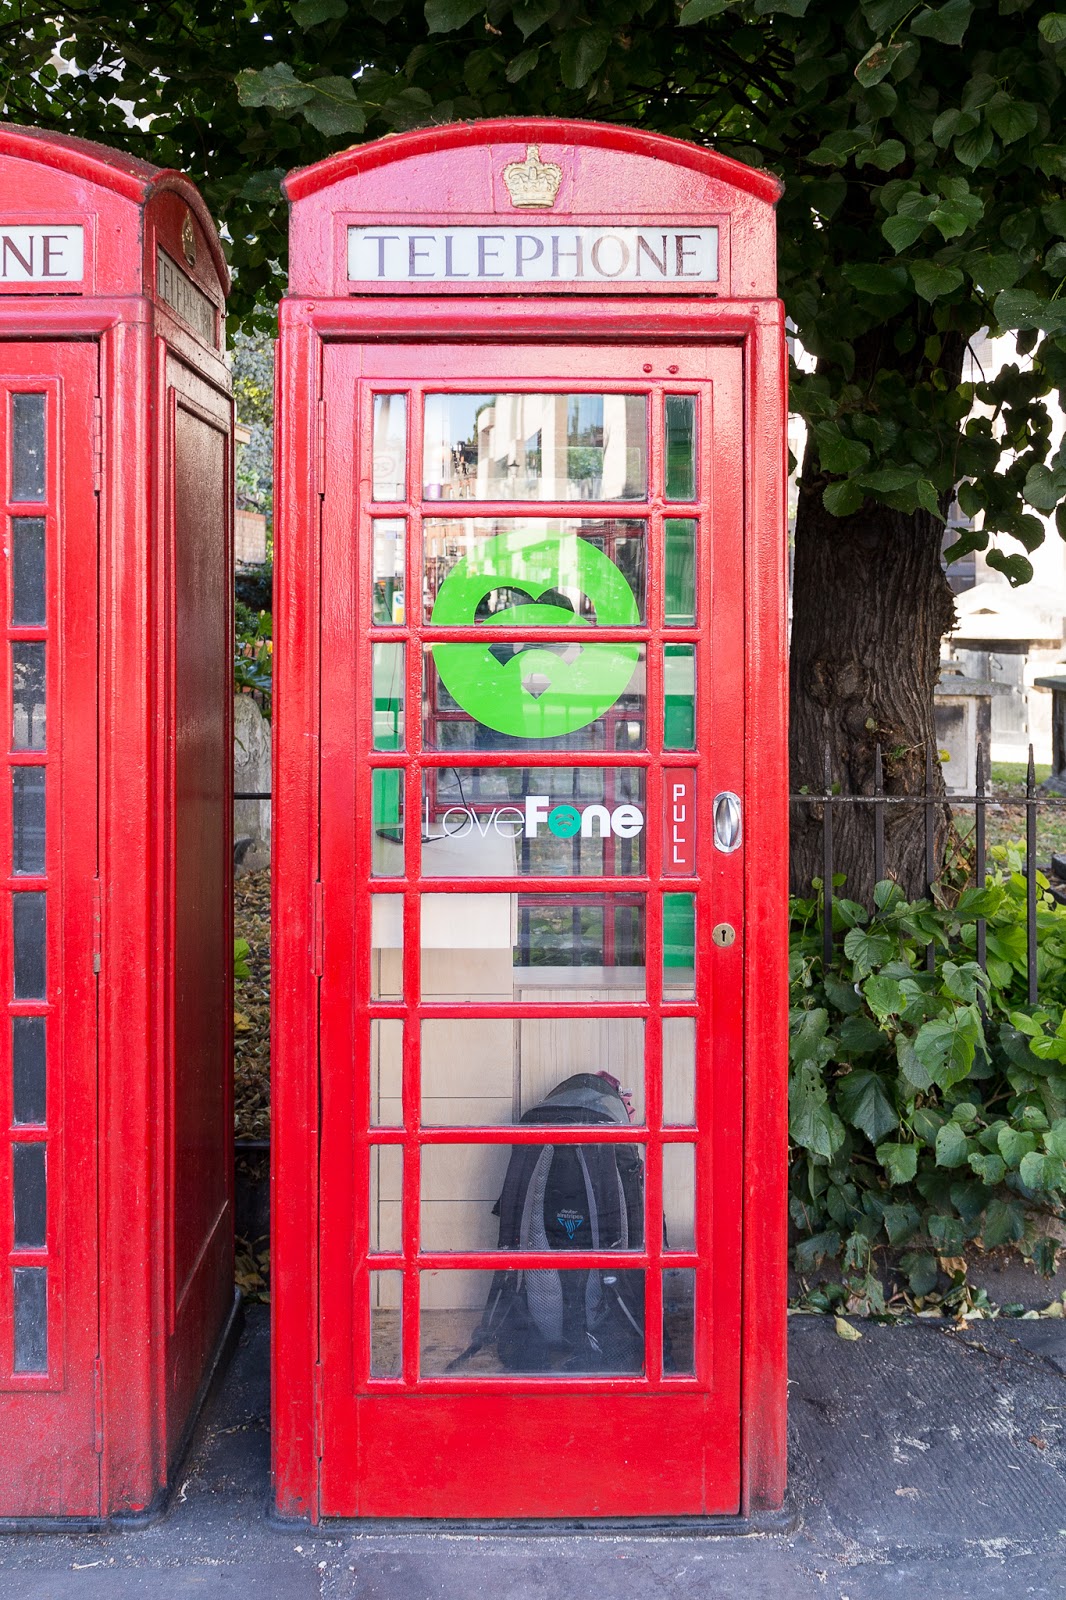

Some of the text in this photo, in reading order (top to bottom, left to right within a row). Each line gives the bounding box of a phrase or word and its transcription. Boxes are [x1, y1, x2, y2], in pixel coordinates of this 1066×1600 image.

[363, 234, 702, 278] TELEPHONE
[157, 255, 214, 342] TELEPH
[672, 783, 686, 863] PULL
